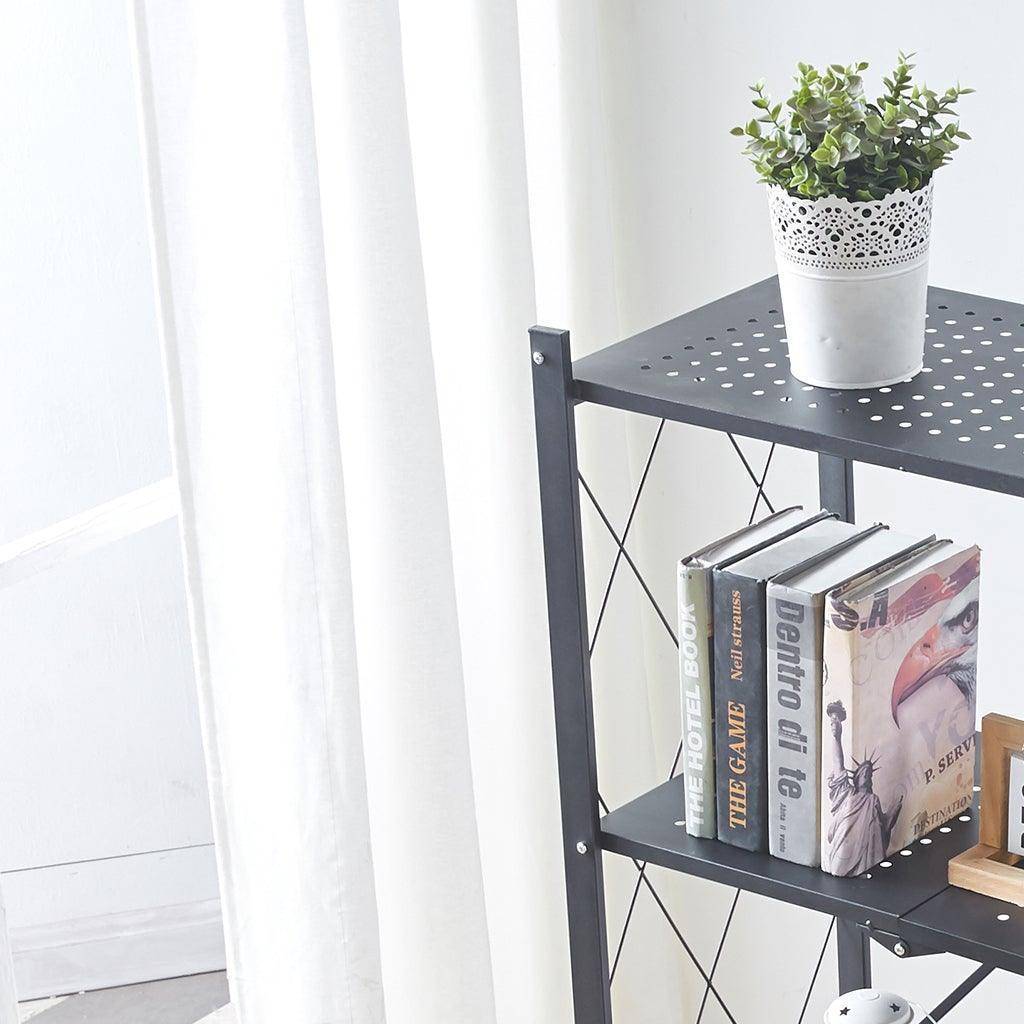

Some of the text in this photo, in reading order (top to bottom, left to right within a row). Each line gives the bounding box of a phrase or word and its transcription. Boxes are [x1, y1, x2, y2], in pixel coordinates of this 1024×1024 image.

[681, 603, 707, 827] THE HOTEL BOOK
[731, 649, 743, 682] Neil
[776, 598, 808, 799] Dentro di te
[728, 700, 748, 829] THE GAME
